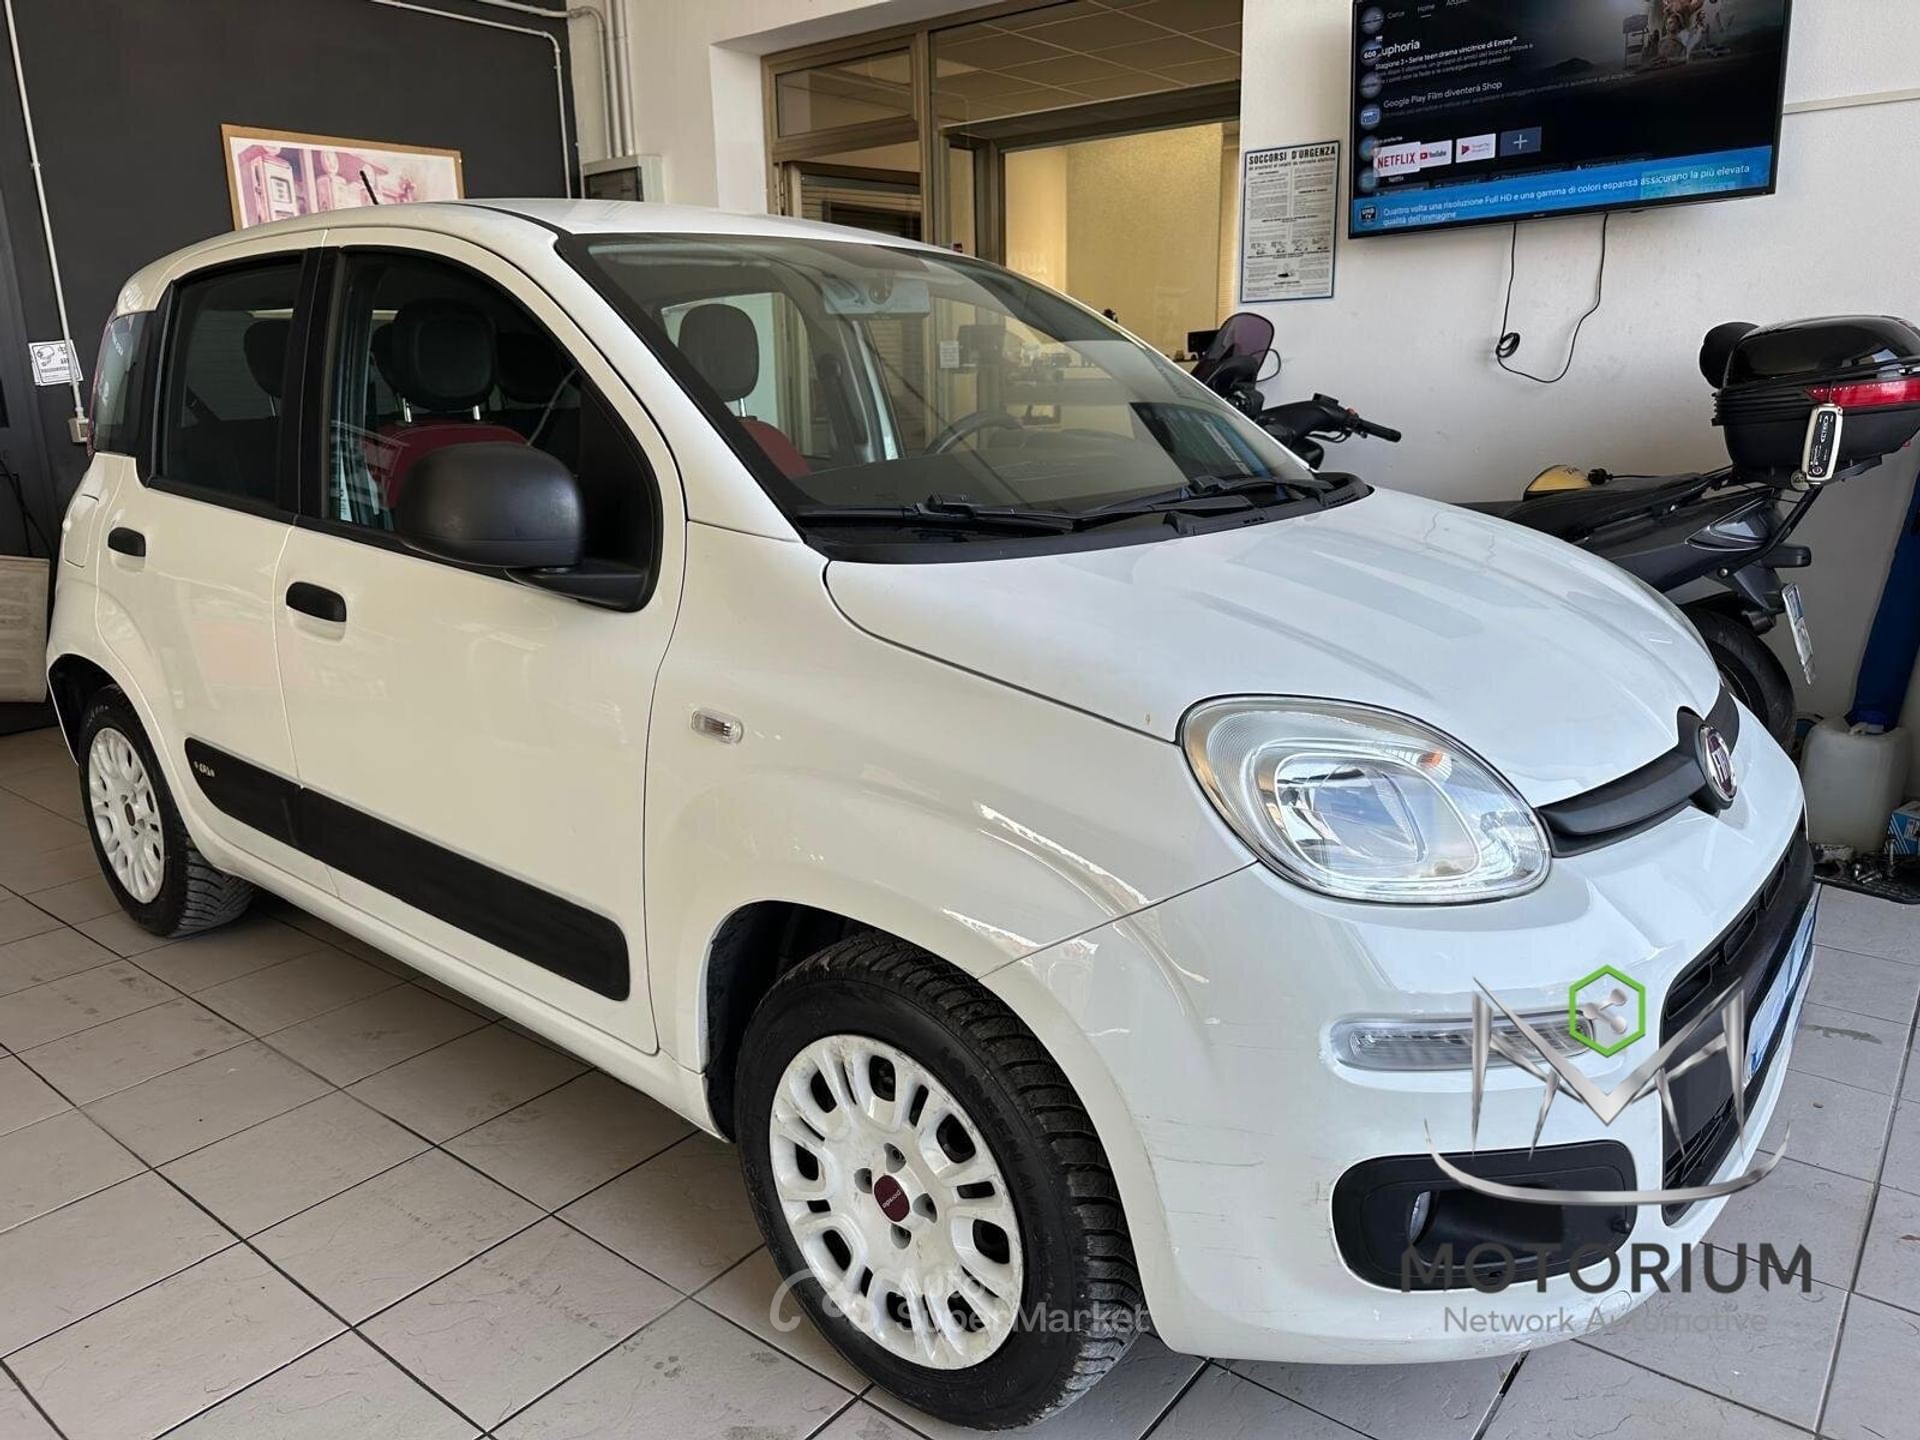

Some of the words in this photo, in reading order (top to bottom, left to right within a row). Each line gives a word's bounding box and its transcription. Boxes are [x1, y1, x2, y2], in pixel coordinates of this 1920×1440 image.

[1384, 98, 1410, 108] Google
[1411, 95, 1427, 104] Play
[1427, 91, 1444, 100] Film
[1482, 81, 1503, 91] Shop
[1249, 151, 1287, 165] SOCCORSI
[1291, 146, 1336, 160] D'URGENZA
[1377, 152, 1416, 169] NETFLIX
[1410, 204, 1428, 213] volta
[1429, 202, 1442, 210] una
[1443, 197, 1484, 208] risoluzione
[1485, 195, 1499, 204] Full
[1500, 193, 1513, 202] HD
[1520, 191, 1535, 200] una
[1536, 188, 1566, 199] gamma
[1568, 186, 1577, 195] di
[1577, 182, 1601, 193] colori
[1602, 178, 1639, 191] espansa
[1640, 172, 1689, 186] assicurano
[1690, 170, 1699, 179] la
[1700, 168, 1715, 179] più
[1716, 165, 1751, 176] elevata
